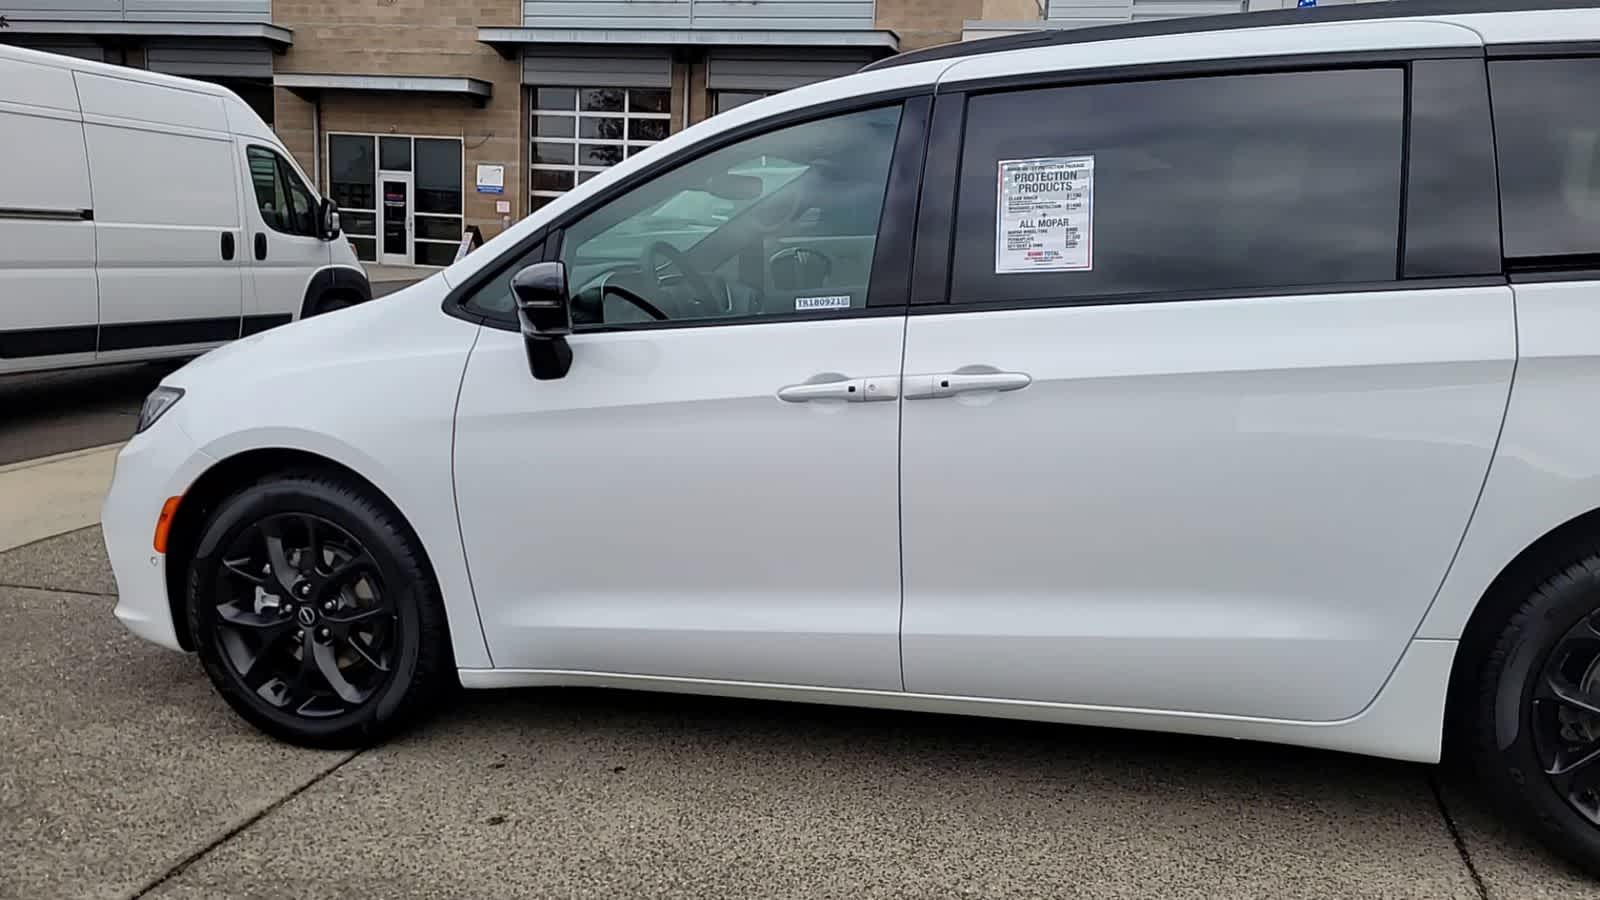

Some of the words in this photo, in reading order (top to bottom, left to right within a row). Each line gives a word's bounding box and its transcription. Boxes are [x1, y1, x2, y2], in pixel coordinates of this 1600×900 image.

[1014, 170, 1078, 182] PROTECTION
[1019, 181, 1073, 193] PRODUCTS
[1019, 219, 1036, 228] ALL
[1038, 218, 1070, 228] MOPAR
